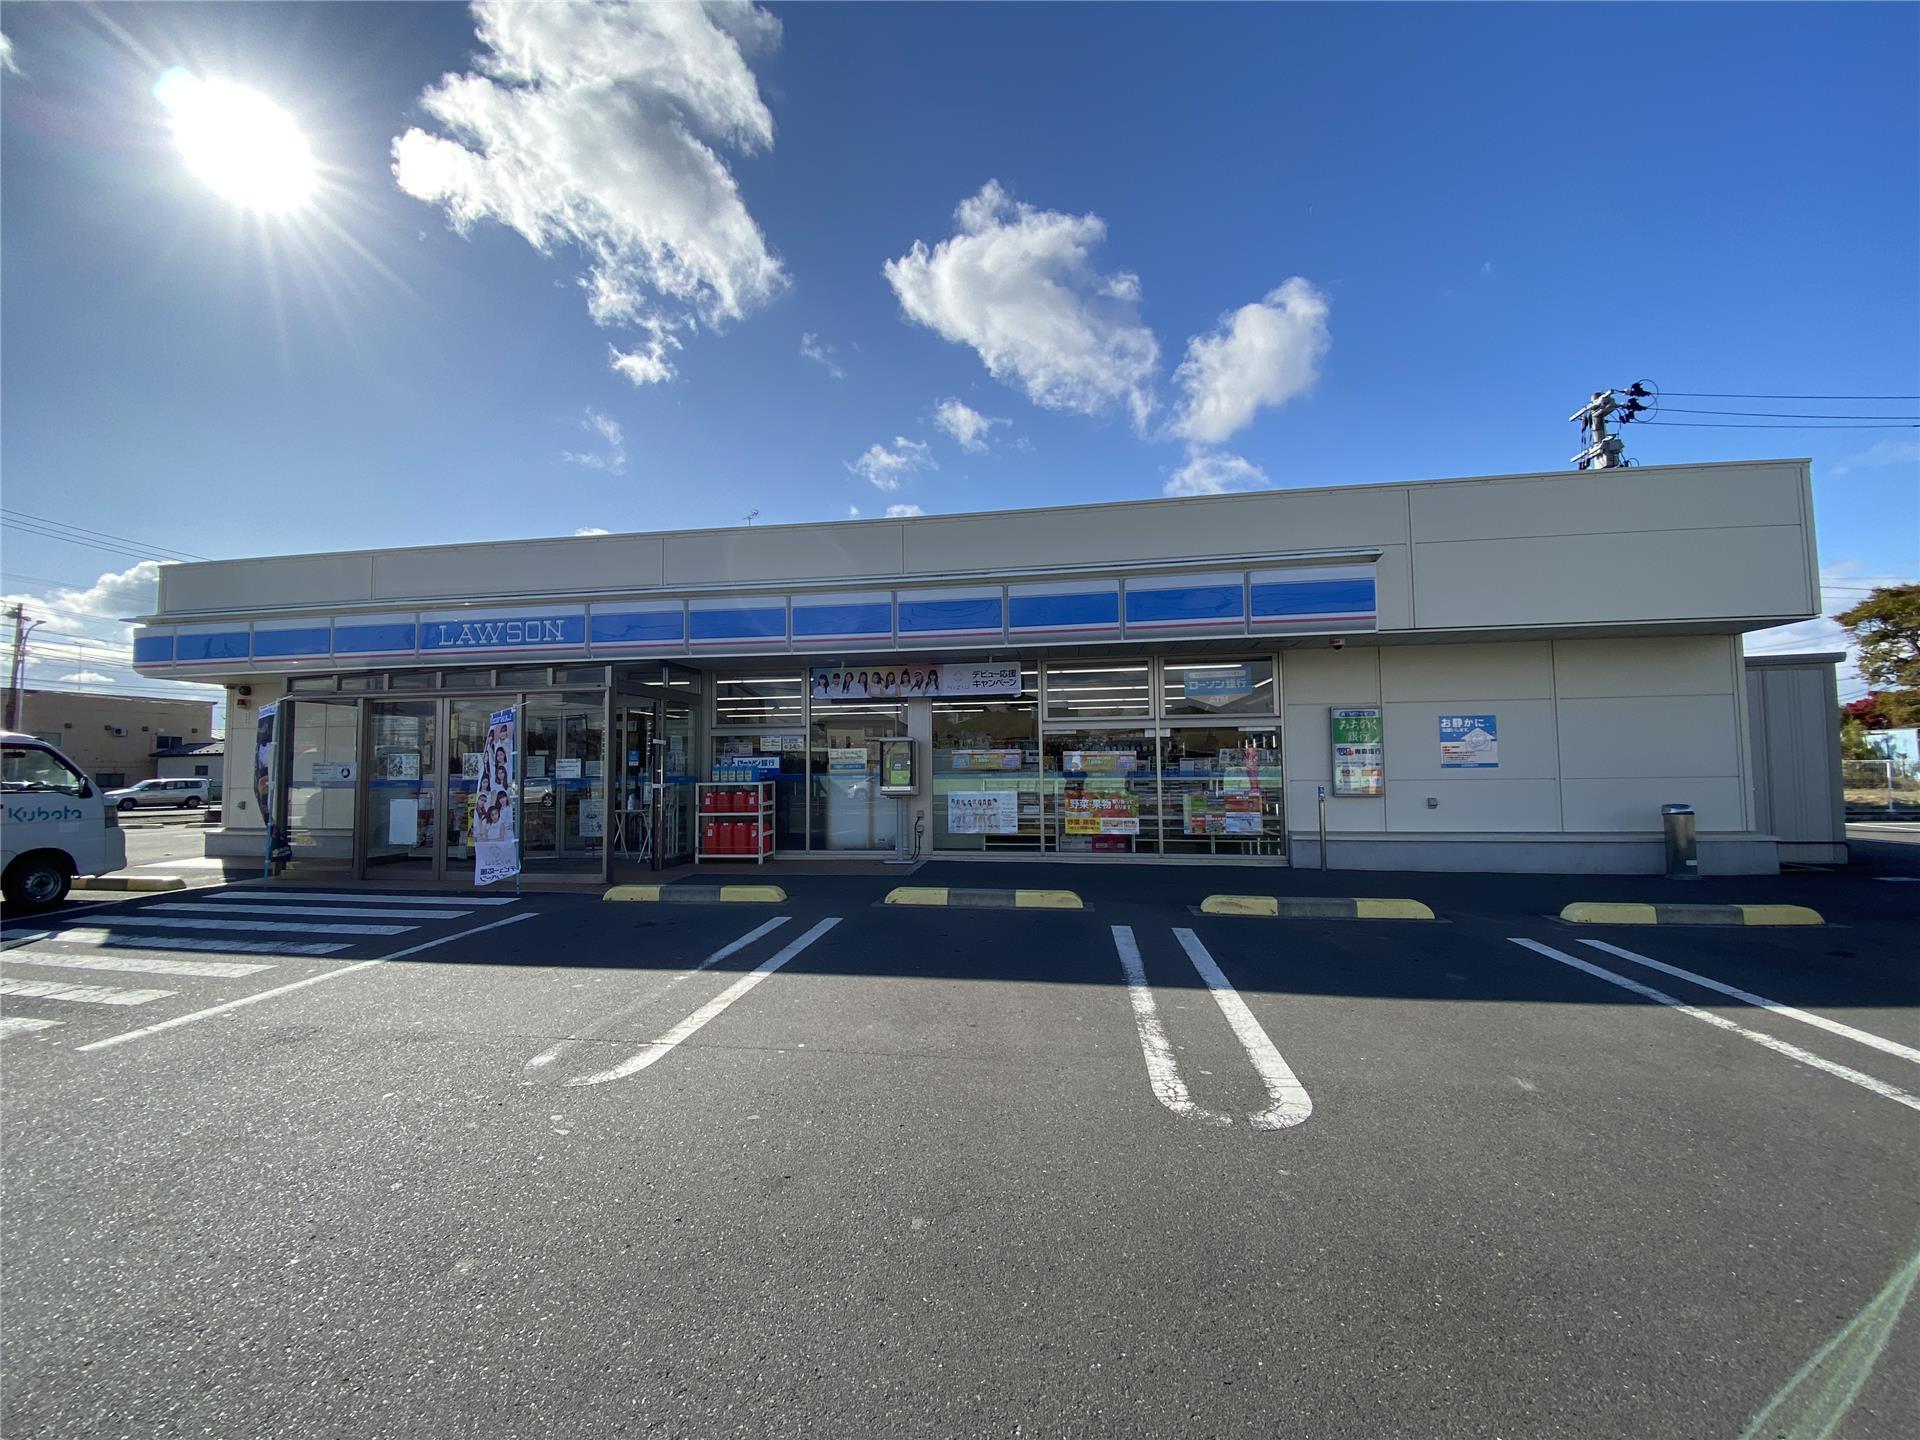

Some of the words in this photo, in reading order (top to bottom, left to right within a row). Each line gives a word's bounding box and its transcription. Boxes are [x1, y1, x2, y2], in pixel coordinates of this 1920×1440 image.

[439, 620, 564, 645] LAWSON
[972, 669, 1016, 678] デビュー応援
[972, 679, 1017, 688] キャンペーン
[1189, 680, 1246, 689] ローソン銀行
[1339, 719, 1377, 730] みちのく
[1441, 718, 1485, 728] お静かに
[1069, 798, 1112, 810] 野菜・果物
[8, 805, 82, 822] Kubota
